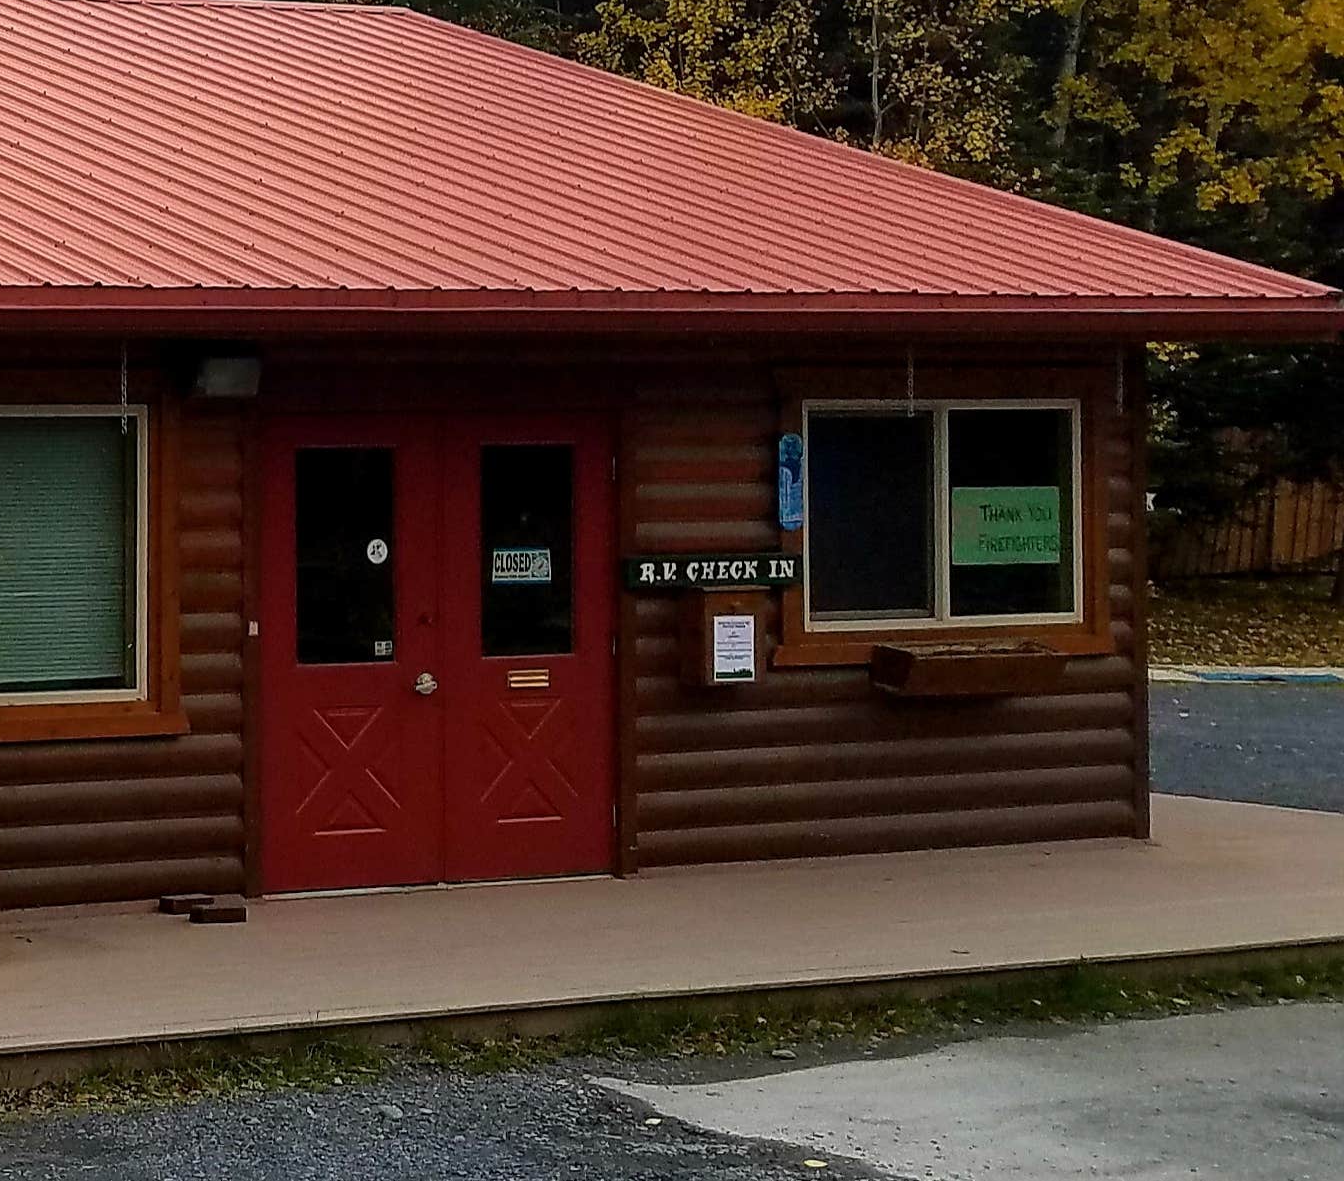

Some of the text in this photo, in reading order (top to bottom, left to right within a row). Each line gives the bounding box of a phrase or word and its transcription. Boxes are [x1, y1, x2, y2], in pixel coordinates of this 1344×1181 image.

[979, 504, 1023, 522] THANK
[494, 552, 531, 573] CLOSED
[639, 560, 795, 584] R.V. CHECK IN
